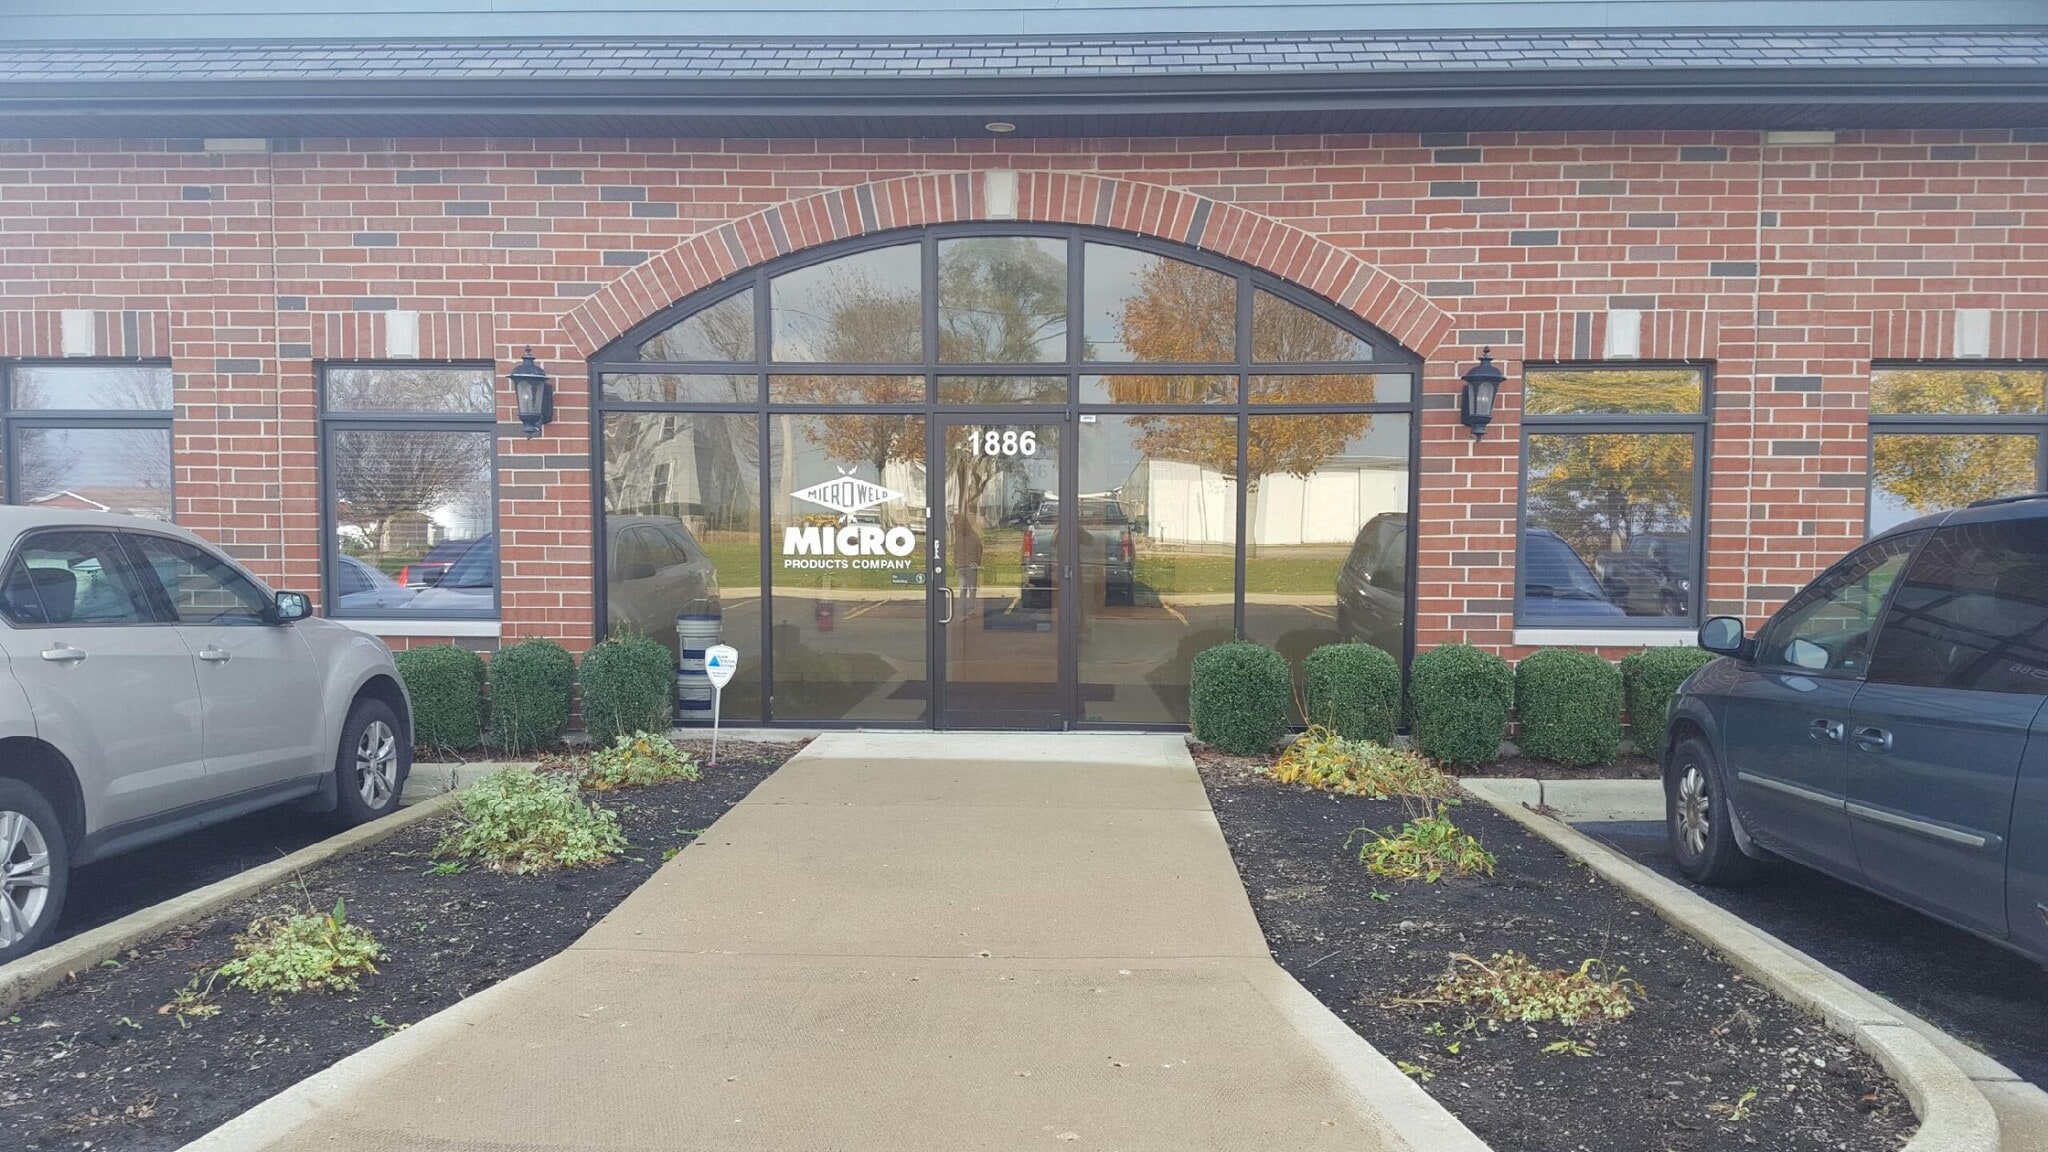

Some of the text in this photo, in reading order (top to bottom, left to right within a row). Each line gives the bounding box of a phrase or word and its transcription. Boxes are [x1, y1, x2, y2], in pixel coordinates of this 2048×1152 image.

[968, 430, 1036, 456] 1886
[782, 526, 916, 557] MICRO
[784, 559, 911, 569] PRODUCTS COMPANY
